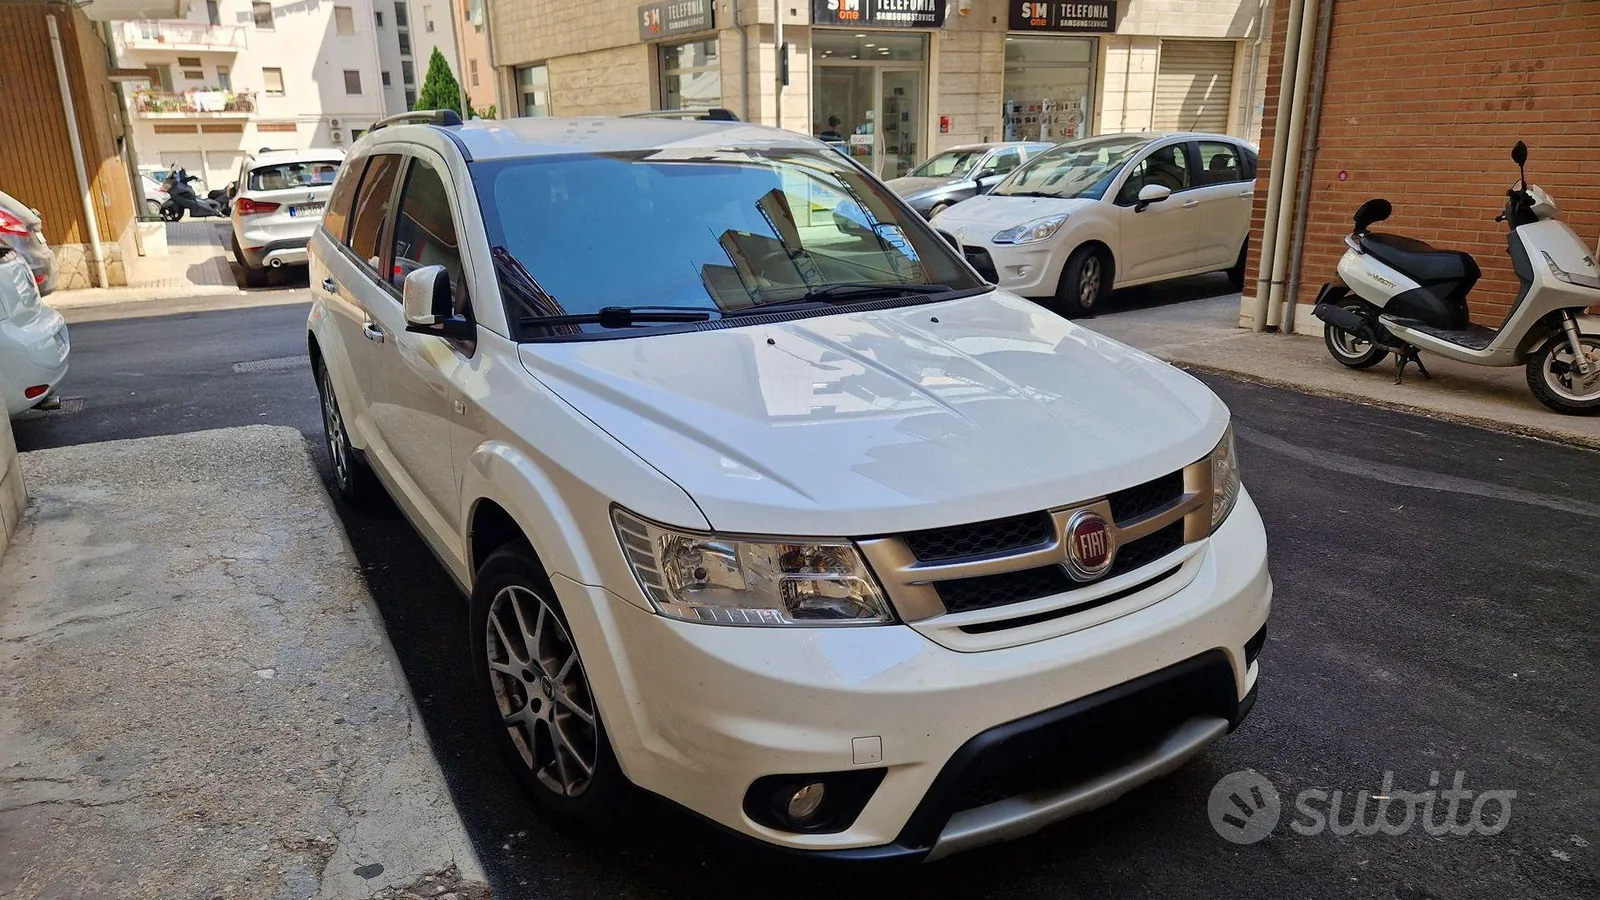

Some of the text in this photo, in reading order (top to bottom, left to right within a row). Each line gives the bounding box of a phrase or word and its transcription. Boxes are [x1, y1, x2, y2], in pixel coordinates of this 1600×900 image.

[668, 0, 704, 20] TELEFONIA
[876, 0, 936, 11] TELEFONIA
[1061, 4, 1108, 18] TELEFONIA
[840, 11, 859, 19] one
[1030, 18, 1047, 26] one
[1080, 530, 1105, 559] FIAT
